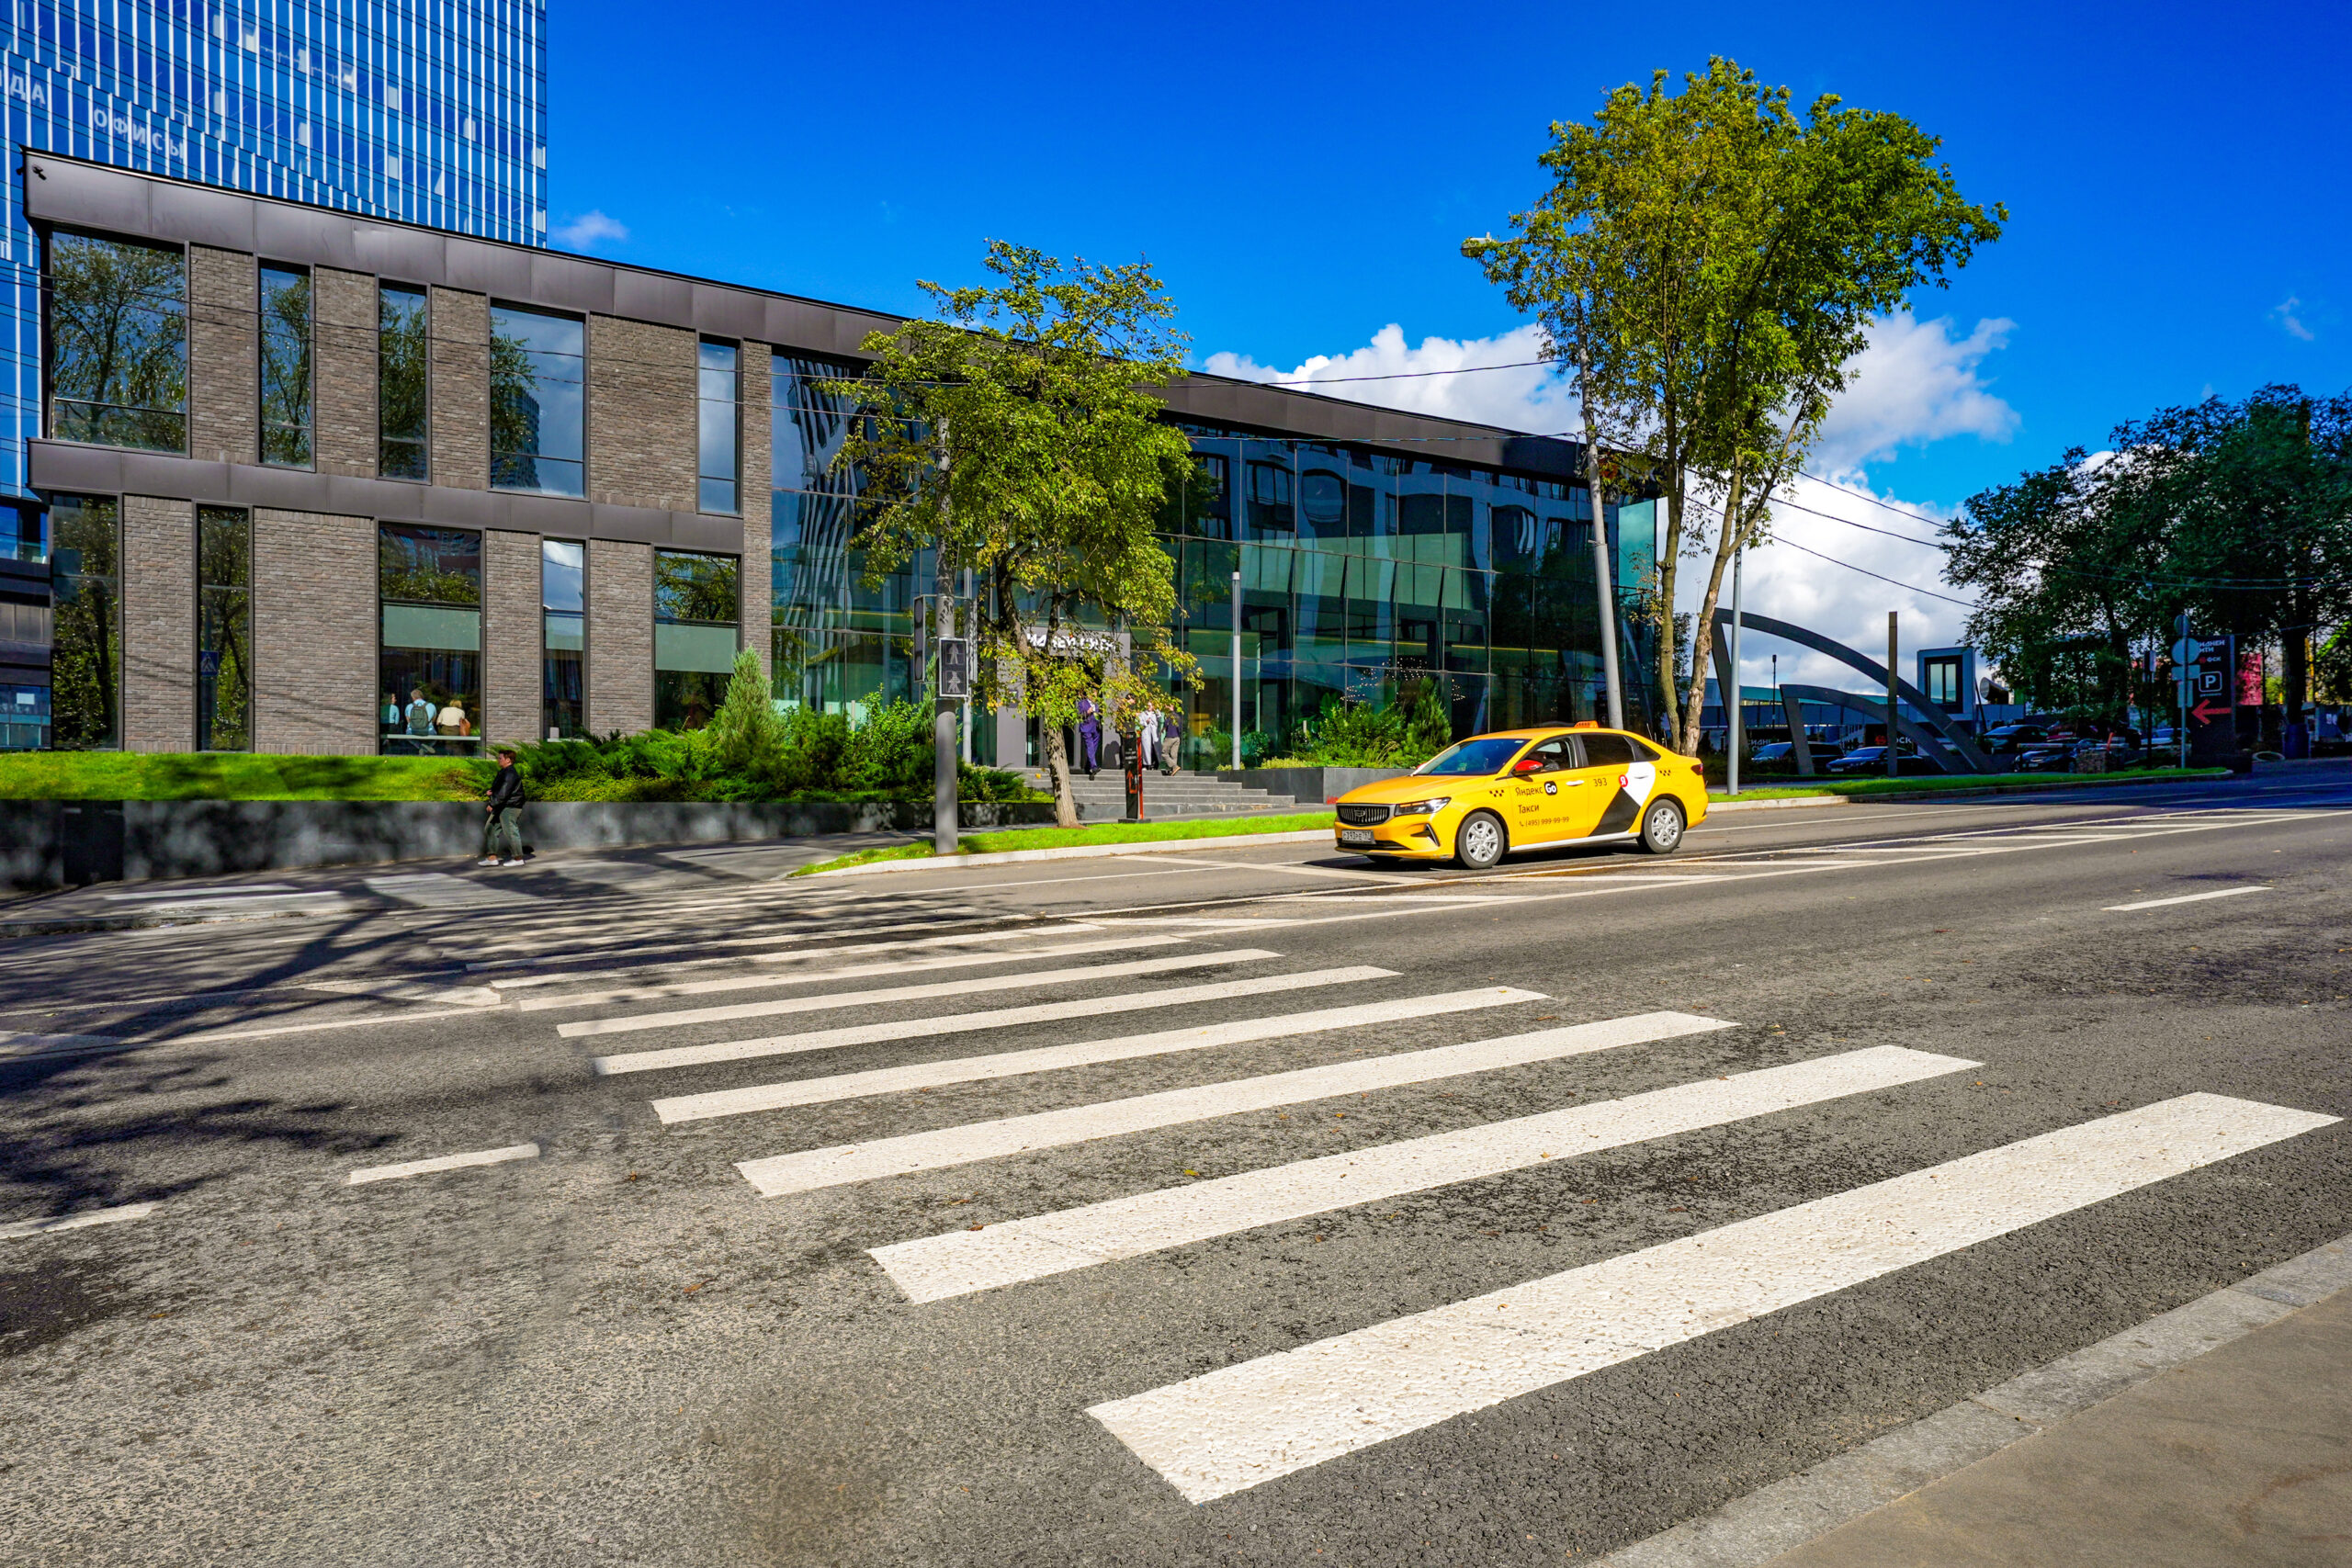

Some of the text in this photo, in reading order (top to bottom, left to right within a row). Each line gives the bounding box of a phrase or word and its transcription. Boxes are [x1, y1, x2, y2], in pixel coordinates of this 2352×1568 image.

[0, 69, 186, 159] ДА ОФИСЫ
[2205, 675, 2216, 688] P
[1593, 777, 1608, 787] 393
[1620, 775, 1627, 786] Я
[1515, 783, 1556, 796] Яндекс Go
[1518, 804, 1540, 814] Такси
[1525, 816, 1570, 827] (495) 999-99-99
